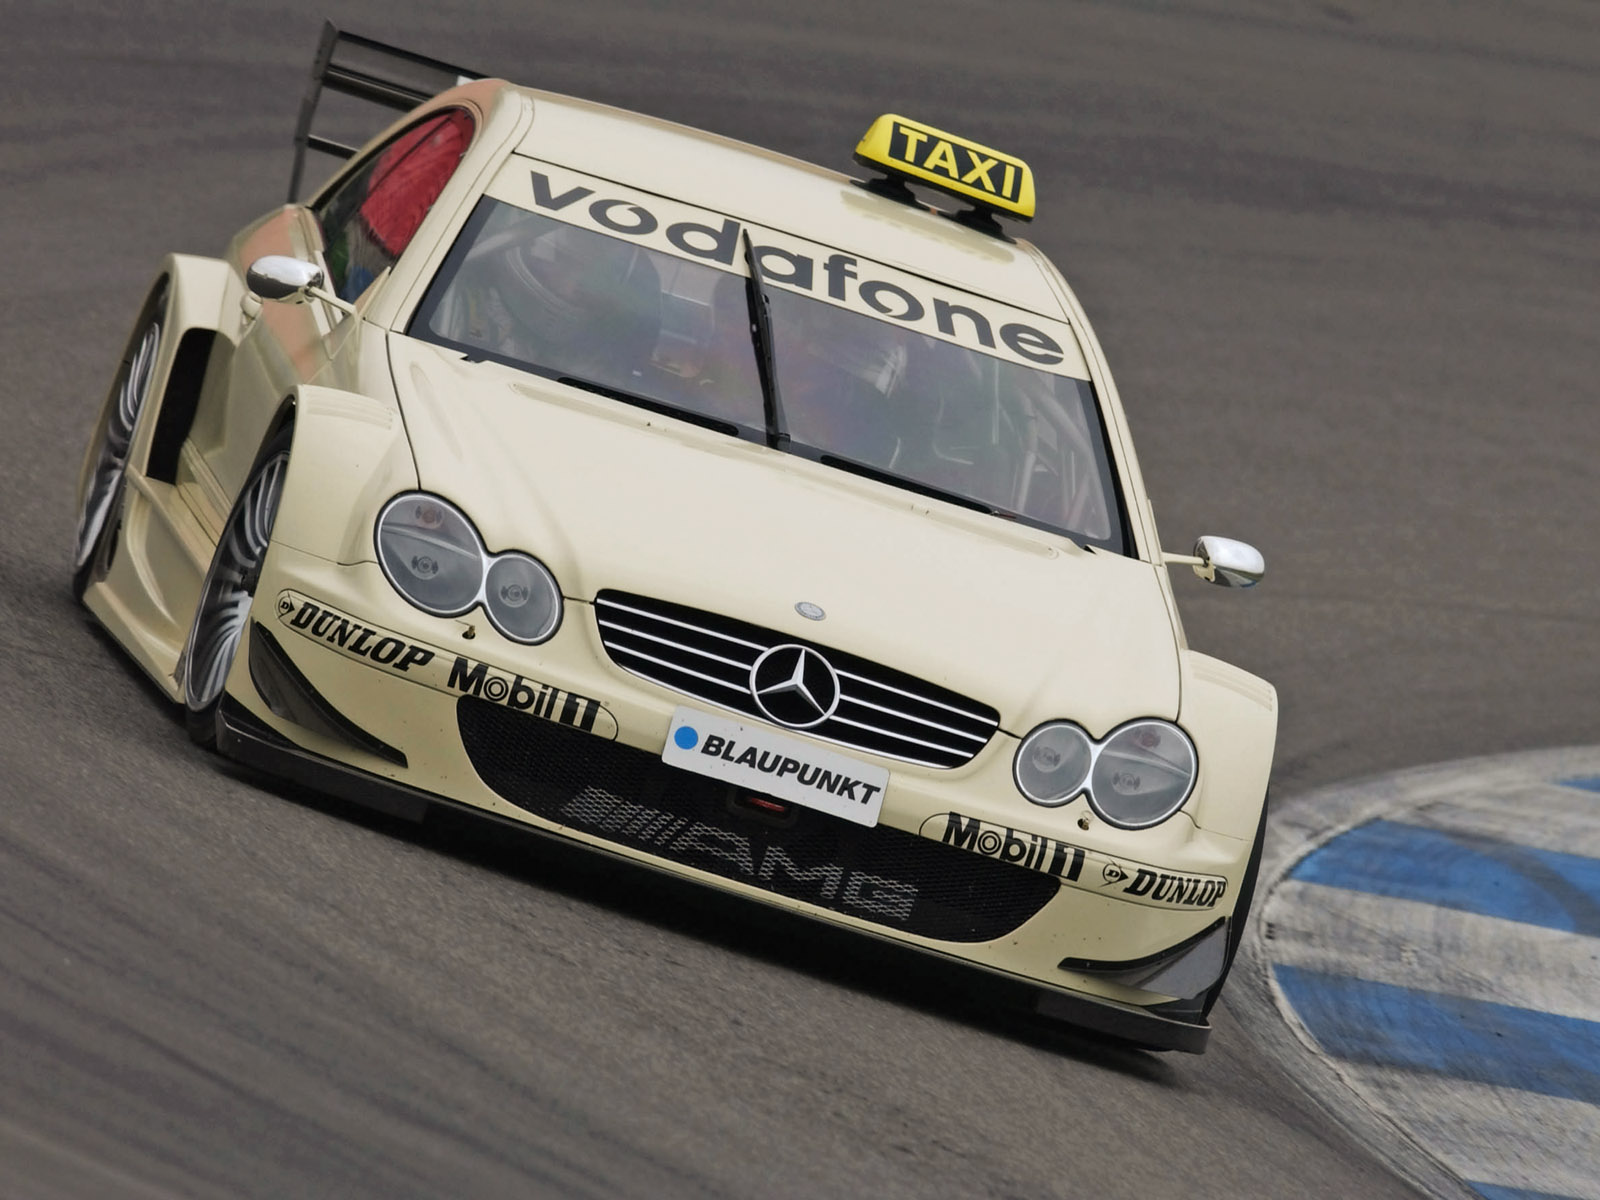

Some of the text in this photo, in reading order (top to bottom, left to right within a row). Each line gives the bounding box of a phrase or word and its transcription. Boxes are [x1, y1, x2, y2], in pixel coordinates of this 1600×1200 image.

[899, 126, 1015, 199] TAXI
[530, 170, 1064, 365] vodafone
[290, 601, 435, 672] DUNLOP
[447, 656, 559, 720] Mobil
[701, 734, 880, 805] BLAUPUNKT
[670, 820, 918, 920] AMG
[942, 811, 1049, 871] Mobil
[1123, 868, 1226, 908] DUNLOP
